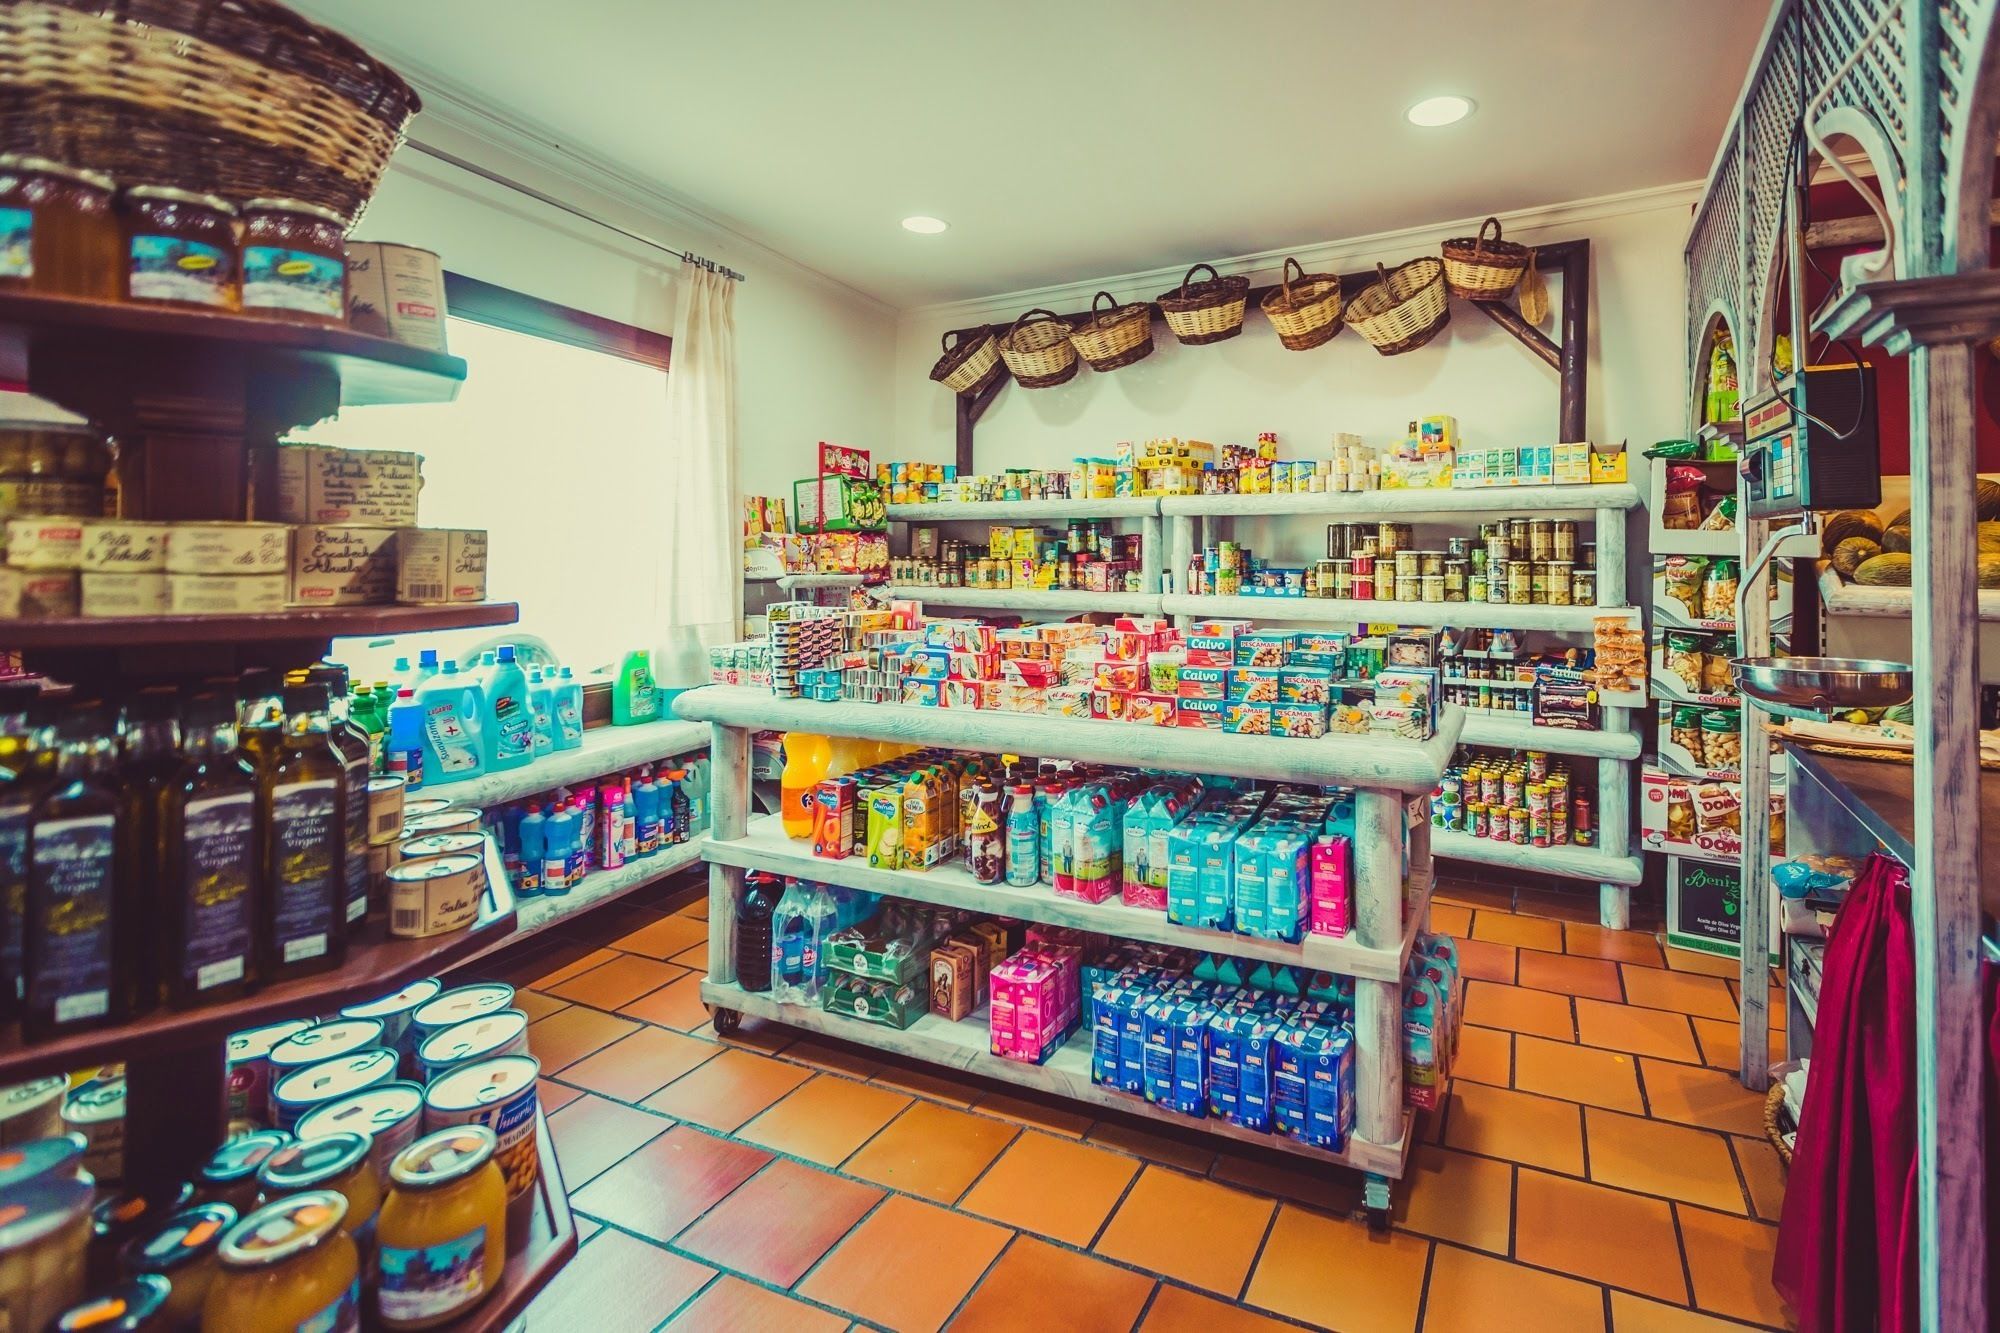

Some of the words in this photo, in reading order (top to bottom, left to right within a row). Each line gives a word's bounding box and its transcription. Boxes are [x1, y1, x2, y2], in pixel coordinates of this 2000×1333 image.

[1191, 638, 1226, 650] Calvo
[1183, 670, 1218, 681] Calvo
[1182, 700, 1217, 711] Calvo
[1699, 836, 1740, 854] DOM
[439, 900, 468, 915] Salsa
[1697, 917, 1711, 925] Aceite
